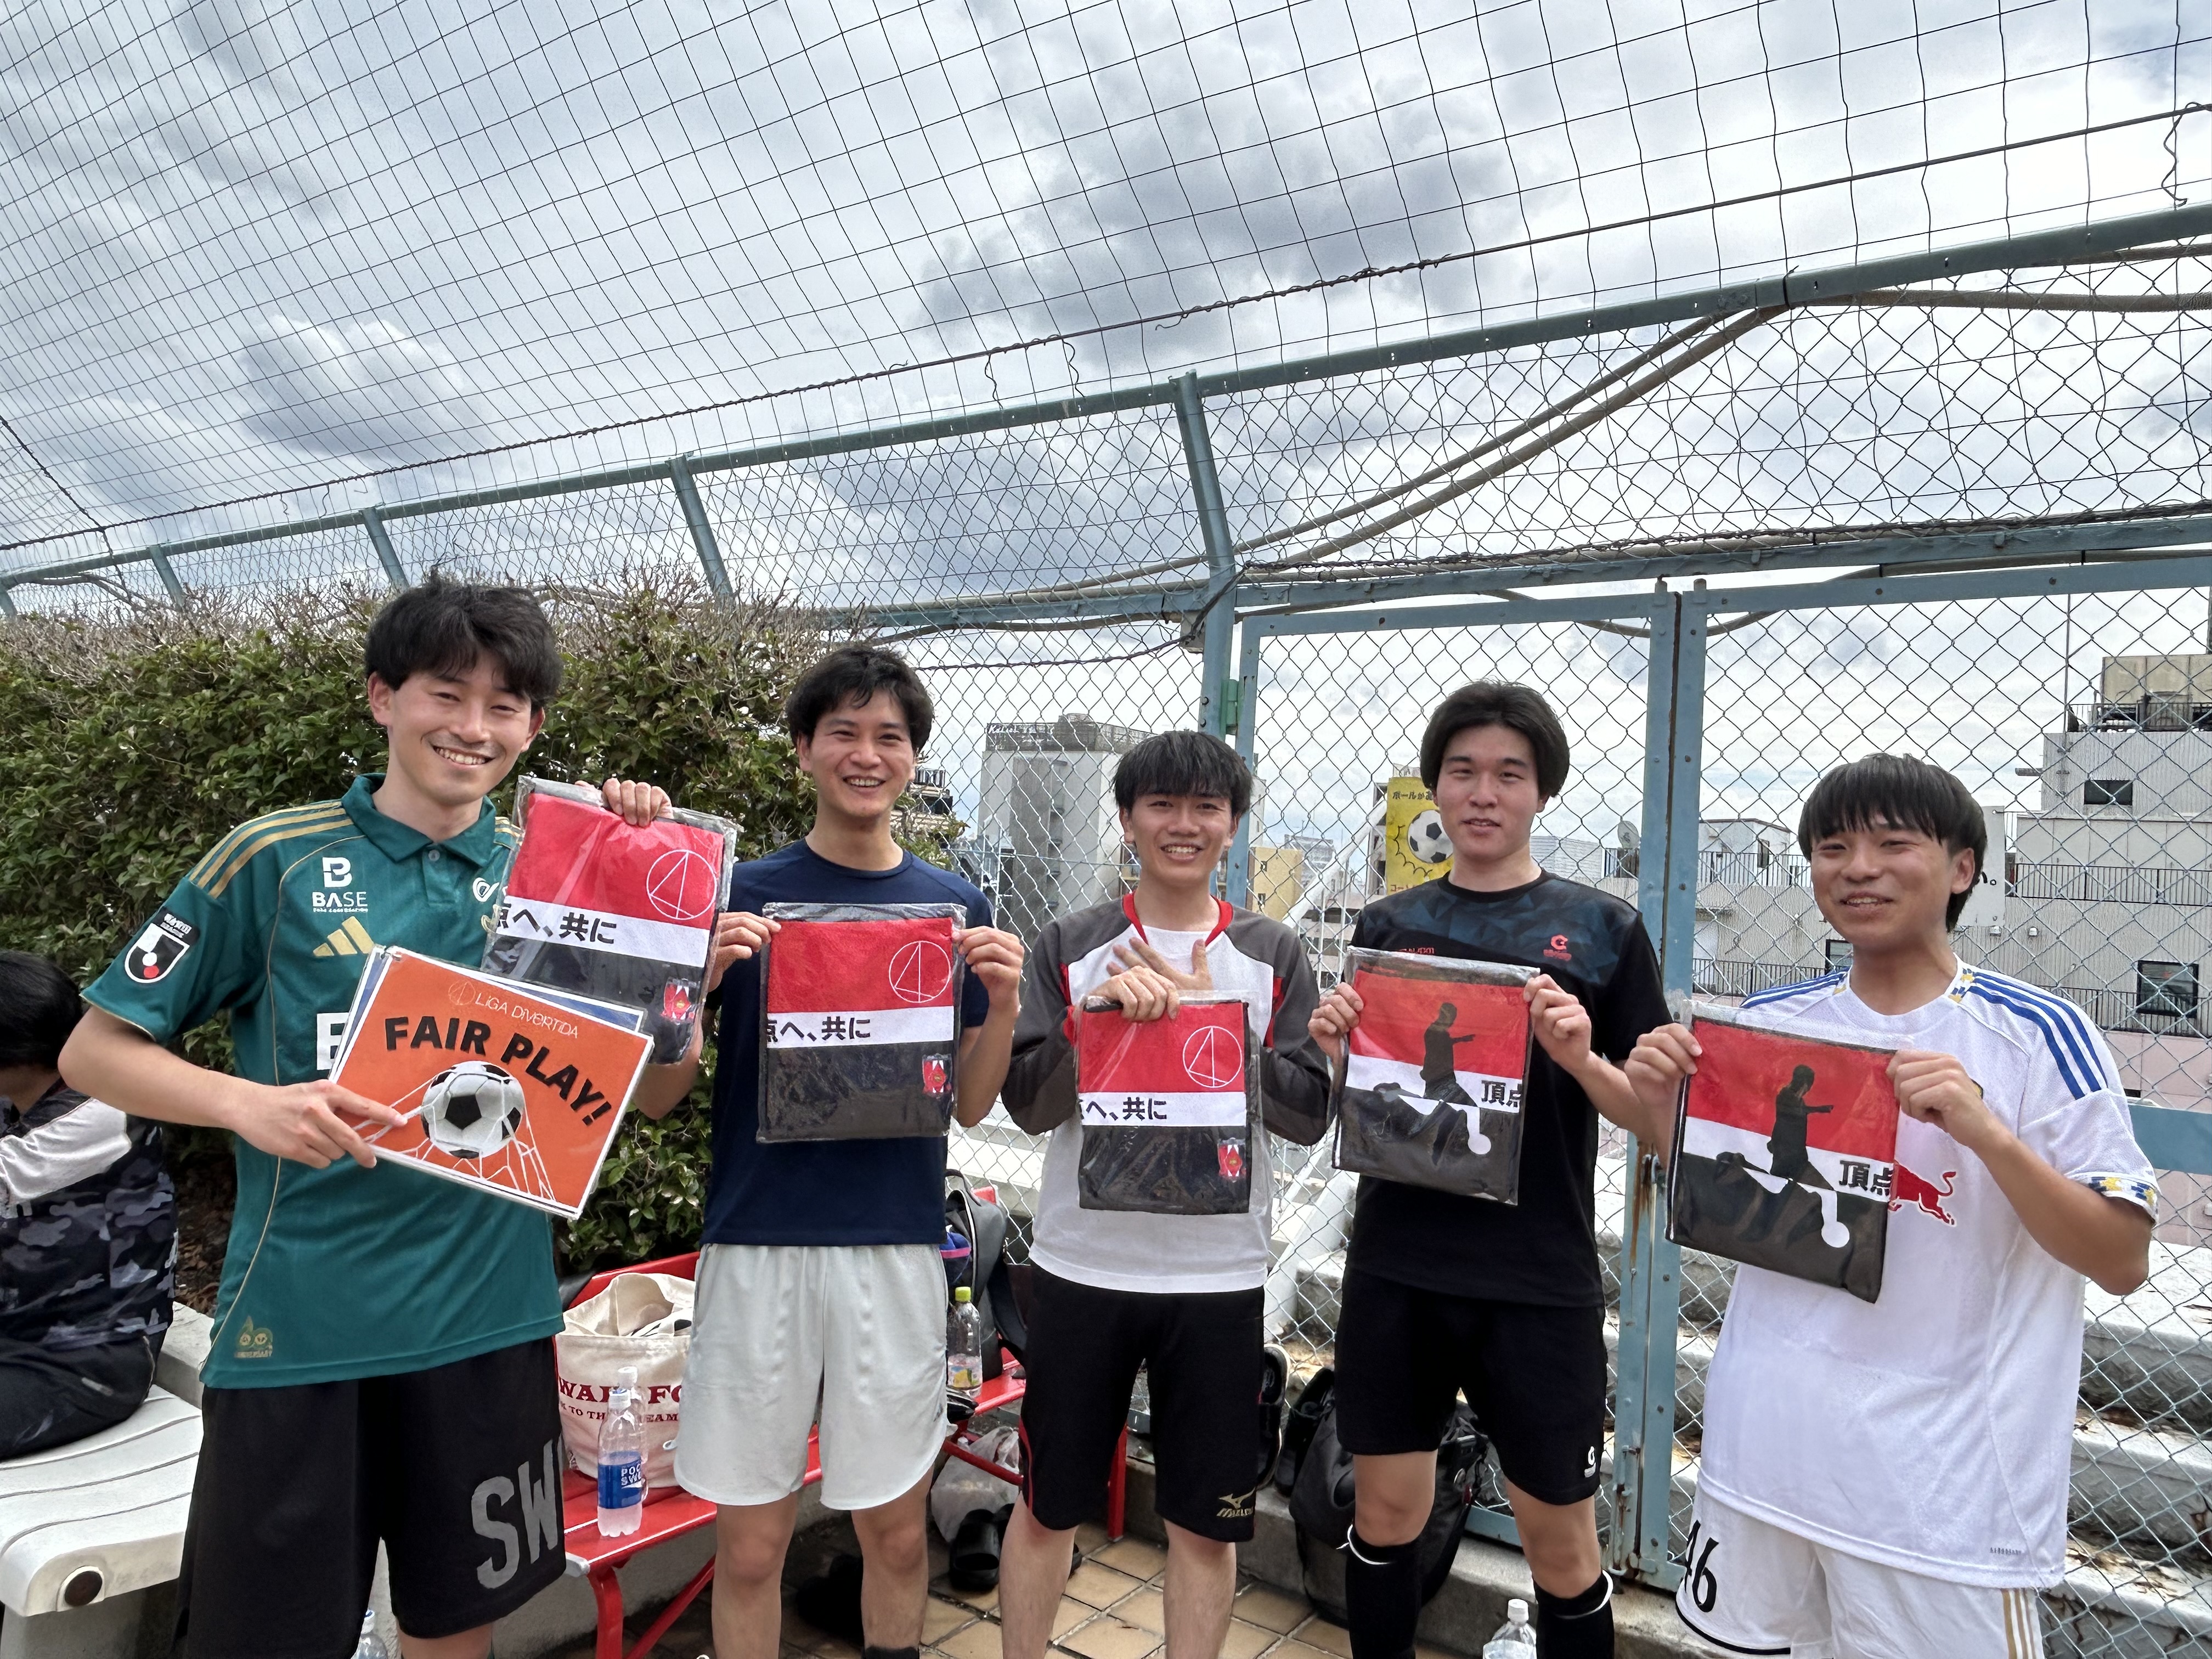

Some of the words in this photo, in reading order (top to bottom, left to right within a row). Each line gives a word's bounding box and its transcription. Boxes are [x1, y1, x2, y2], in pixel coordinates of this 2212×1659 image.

[312, 891, 368, 907] BASE
[385, 1015, 492, 1057] FAIR
[500, 1032, 612, 1126] PLAY!
[1839, 1160, 1894, 1197] 頂点
